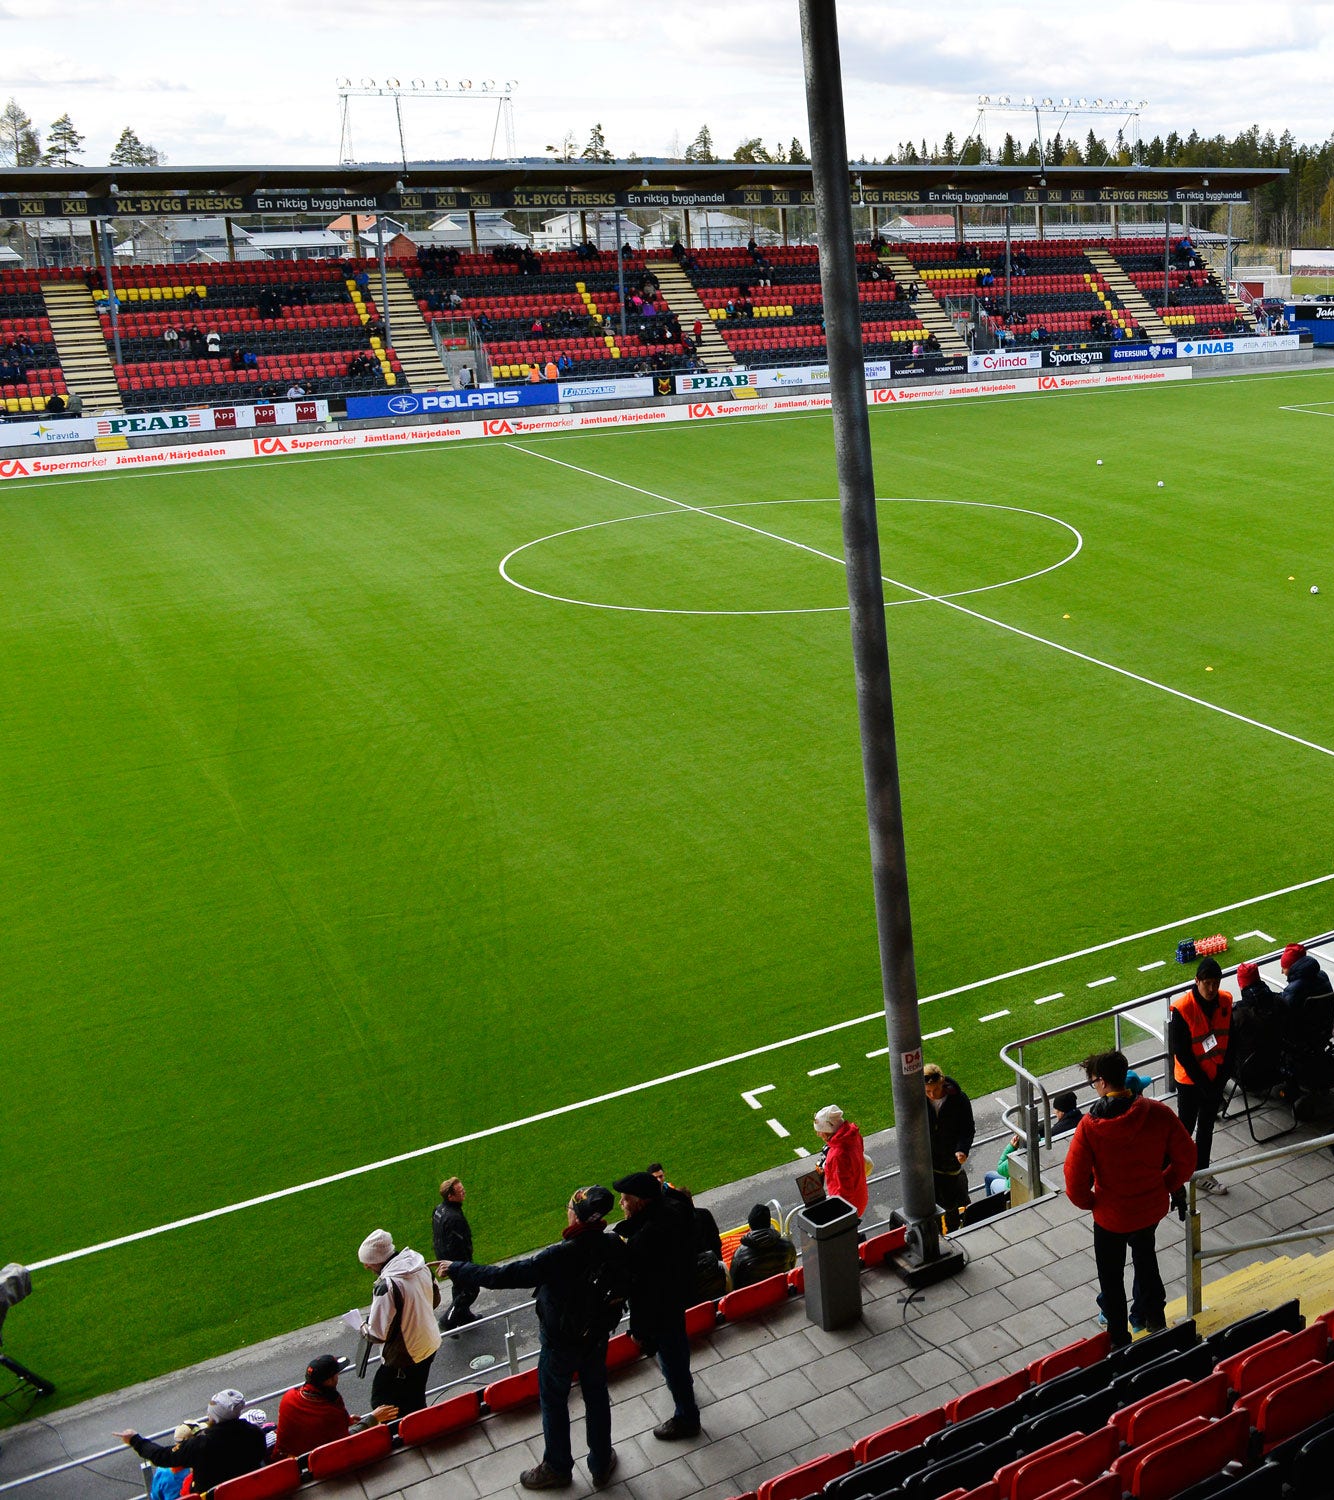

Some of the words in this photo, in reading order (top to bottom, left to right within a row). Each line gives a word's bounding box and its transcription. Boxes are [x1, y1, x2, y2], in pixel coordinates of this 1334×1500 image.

[514, 194, 567, 205] XL-BYGG
[570, 193, 616, 205] FRESKS
[628, 194, 641, 204] En
[643, 193, 669, 205] riktig
[671, 193, 725, 205] bygghandel
[850, 191, 879, 201] -BYGG
[882, 191, 920, 201] FRESKS
[929, 192, 939, 200] En
[941, 191, 963, 202] riktig
[964, 191, 1009, 202] bygghandel
[1100, 190, 1135, 200] XL-BYGG
[1137, 190, 1169, 200] FRESKS
[1176, 191, 1185, 199] En
[1187, 191, 1203, 200] riktig
[1205, 191, 1242, 200] bygghandel
[116, 199, 182, 213] XL-BYGG
[186, 197, 243, 211] FRESKS
[257, 198, 273, 209] En
[276, 197, 308, 211] riktig
[311, 197, 377, 211] bygghandel
[1114, 349, 1148, 359] ÖSTERSUND
[1197, 341, 1234, 355] INAB
[983, 356, 1027, 370] Cylinda
[1049, 349, 1103, 367] Sportsgym
[691, 374, 750, 390] PEAB
[780, 377, 803, 386] bravida
[1038, 376, 1059, 390] ICA
[1061, 376, 1101, 388] Supermarket
[422, 390, 520, 410] POLARIS
[873, 389, 897, 403] ICA
[899, 388, 944, 400] Supermarket
[688, 403, 715, 419] ICA
[716, 402, 768, 415] Supermarket
[46, 431, 80, 441] bravida
[108, 414, 190, 434] PEAB
[483, 420, 514, 436] ICA
[515, 418, 575, 432] Supermarket
[253, 437, 288, 455] ICA
[290, 435, 357, 450] Supermarket
[363, 427, 461, 443] Jämtland/Härjedalen
[0, 459, 30, 477] CA
[33, 457, 107, 473] Supermarket
[115, 448, 226, 465] Jämtland/Härjedalen
[905, 1050, 920, 1064] D4
